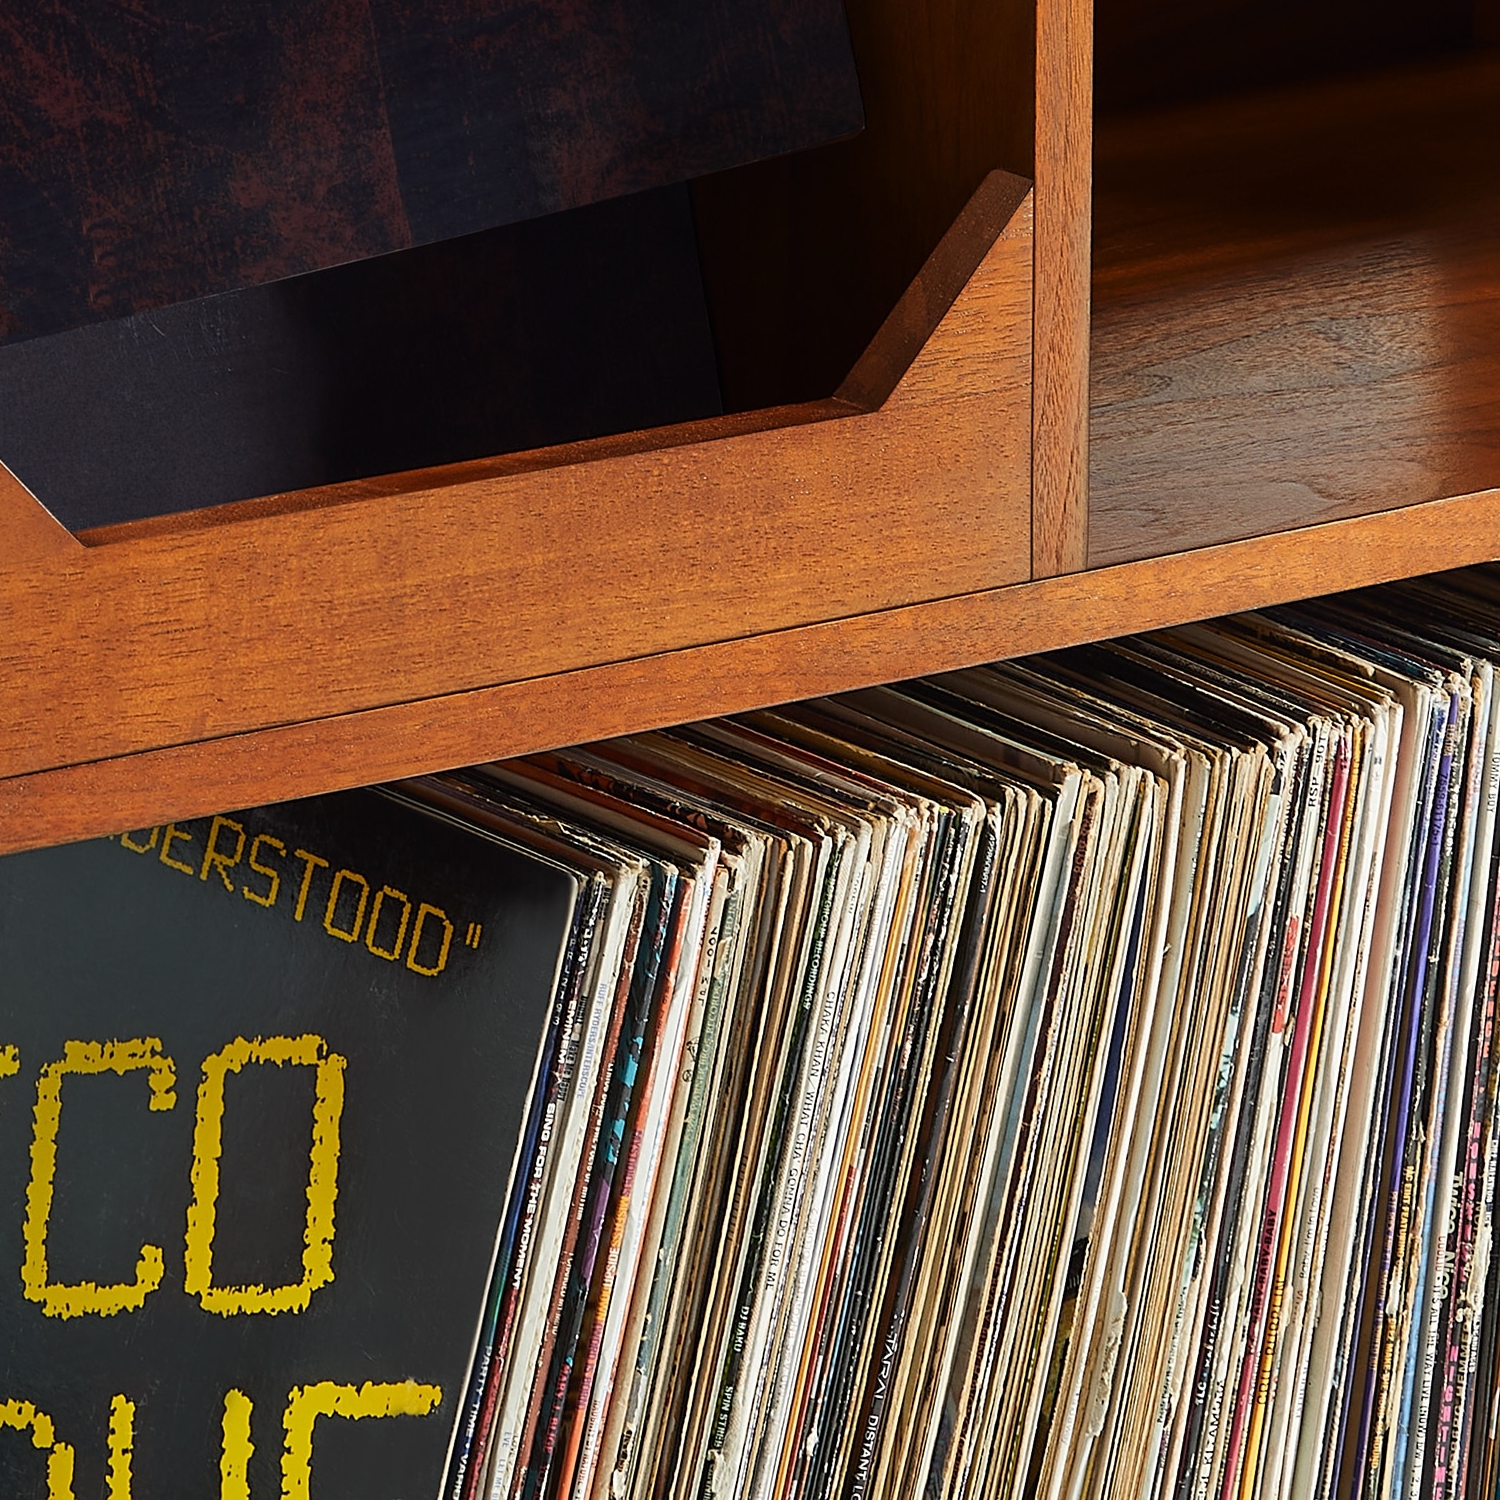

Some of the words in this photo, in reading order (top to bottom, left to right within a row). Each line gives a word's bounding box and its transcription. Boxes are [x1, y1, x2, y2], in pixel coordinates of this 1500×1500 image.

[1443, 722, 1455, 757] ELEKTRA
[1490, 750, 1500, 789] TOMMY
[1486, 792, 1495, 813] BOY
[596, 983, 607, 1005] RUFF
[819, 990, 834, 1035] CHAKA
[556, 999, 577, 1064] EMINEM
[576, 1007, 601, 1099] RYDERS/INTERSCOPE
[810, 1040, 824, 1077] KHAN
[541, 1102, 556, 1142] SING
[800, 1089, 814, 1127] WHAT
[533, 1145, 546, 1179] FOR
[781, 1167, 797, 1215] GONNA
[777, 1219, 787, 1237] DO
[1397, 1207, 1410, 1257] FEATURING
[510, 1218, 533, 1290] MOMENT
[771, 1241, 782, 1264] FOR
[765, 1271, 776, 1291] ME
[1428, 1307, 1438, 1325] ALL
[474, 1345, 492, 1396] PARTY
[555, 1363, 569, 1399] MARY
[1422, 1352, 1434, 1376] WAY
[721, 1384, 733, 1411] SPIN
[1420, 1379, 1431, 1401] LIVE
[464, 1400, 480, 1437] TIME
[543, 1416, 557, 1453] BLIGE
[500, 1431, 512, 1448] EVE
[855, 1413, 878, 1480] DISTANT
